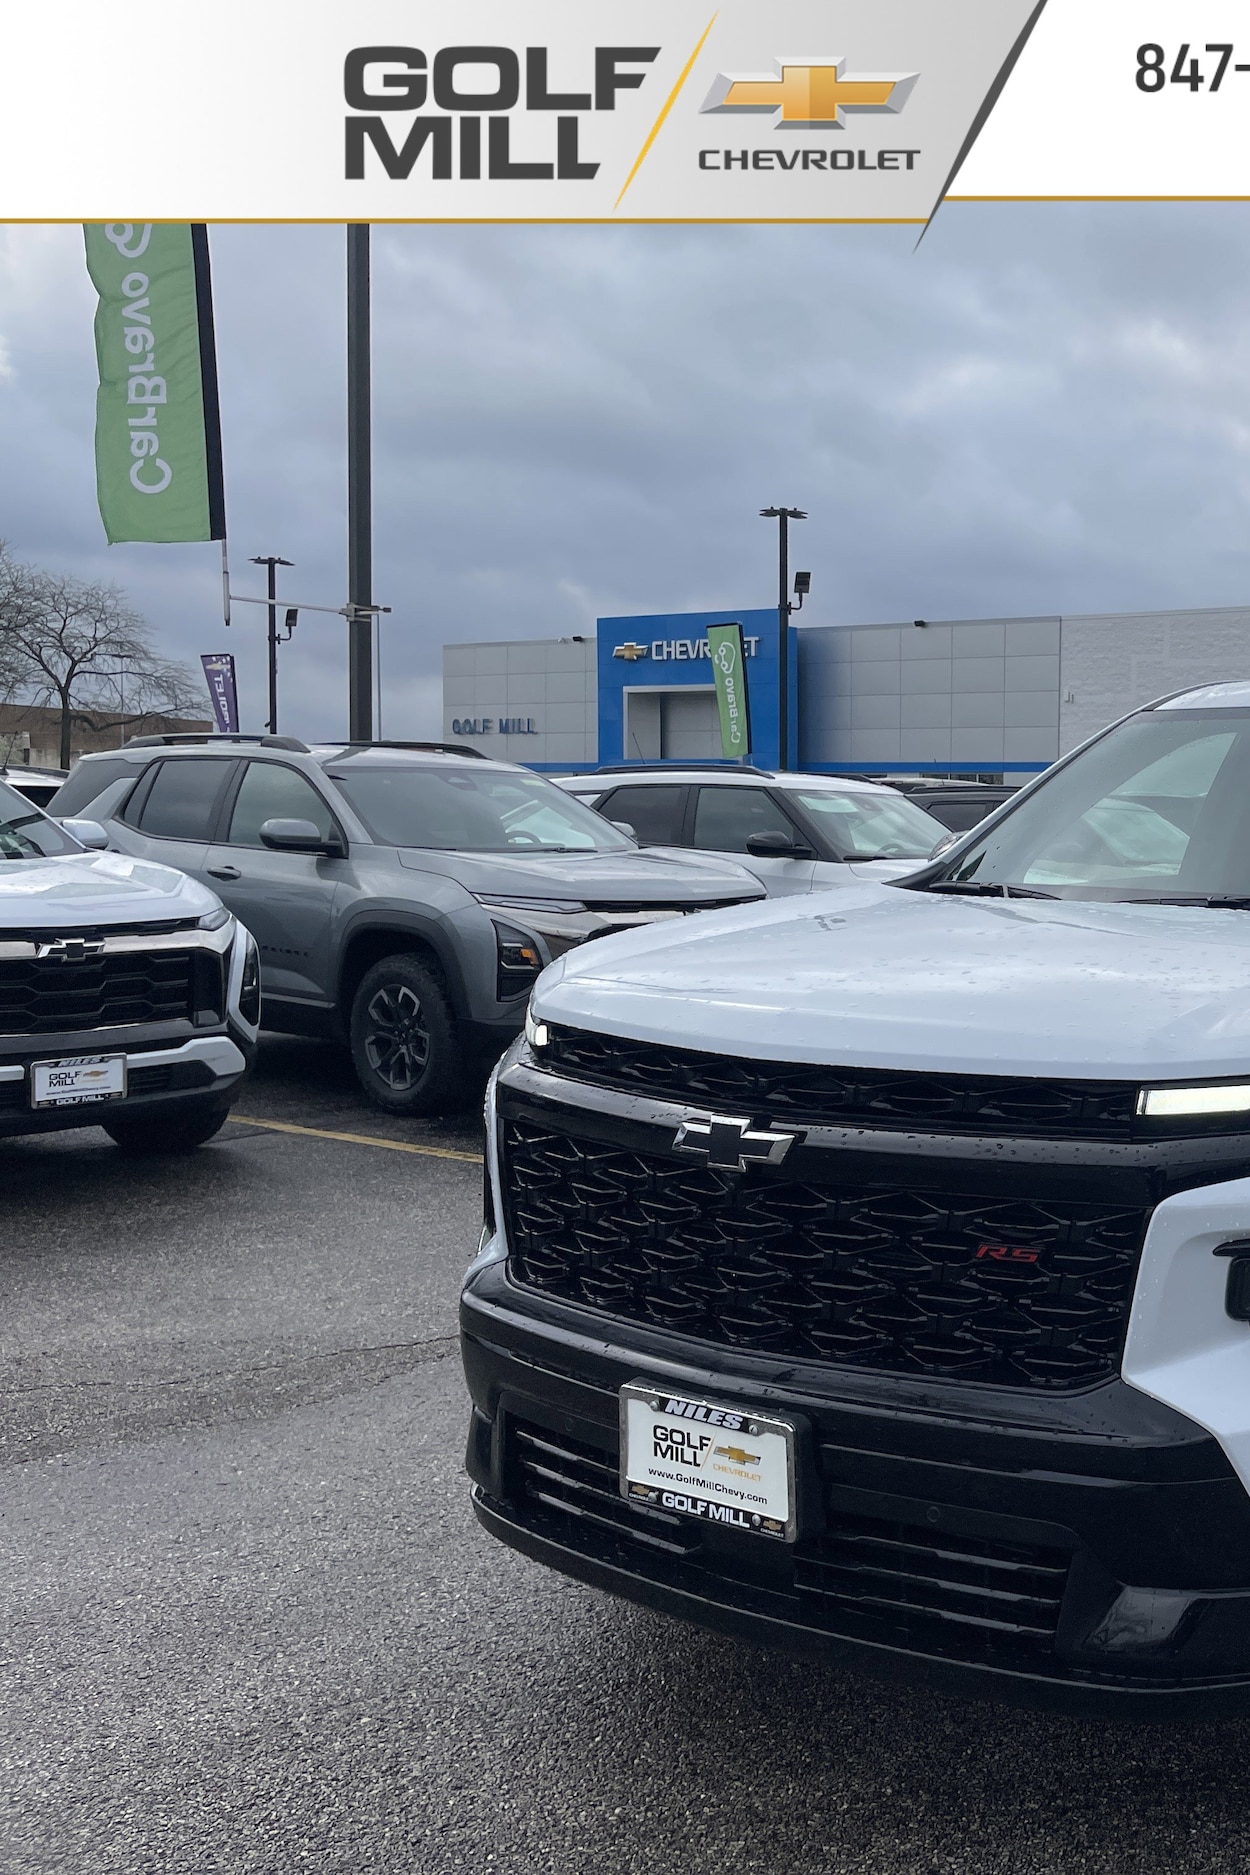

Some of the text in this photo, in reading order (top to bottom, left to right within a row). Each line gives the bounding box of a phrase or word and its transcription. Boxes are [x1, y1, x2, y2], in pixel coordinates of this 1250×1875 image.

[651, 636, 760, 661] CHEVRT
[452, 717, 539, 735] GOLF MILL
[49, 1071, 82, 1081] GOLF
[49, 1078, 76, 1087] MILL
[976, 1243, 1041, 1264] RS
[664, 1399, 744, 1431] NILES
[653, 1424, 711, 1451] GOLF
[653, 1441, 702, 1468] MILL
[712, 1463, 763, 1482] CHEVROLET
[648, 1467, 769, 1505] www.GolfMillChevy.com
[661, 1492, 751, 1529] GOLF MILL
